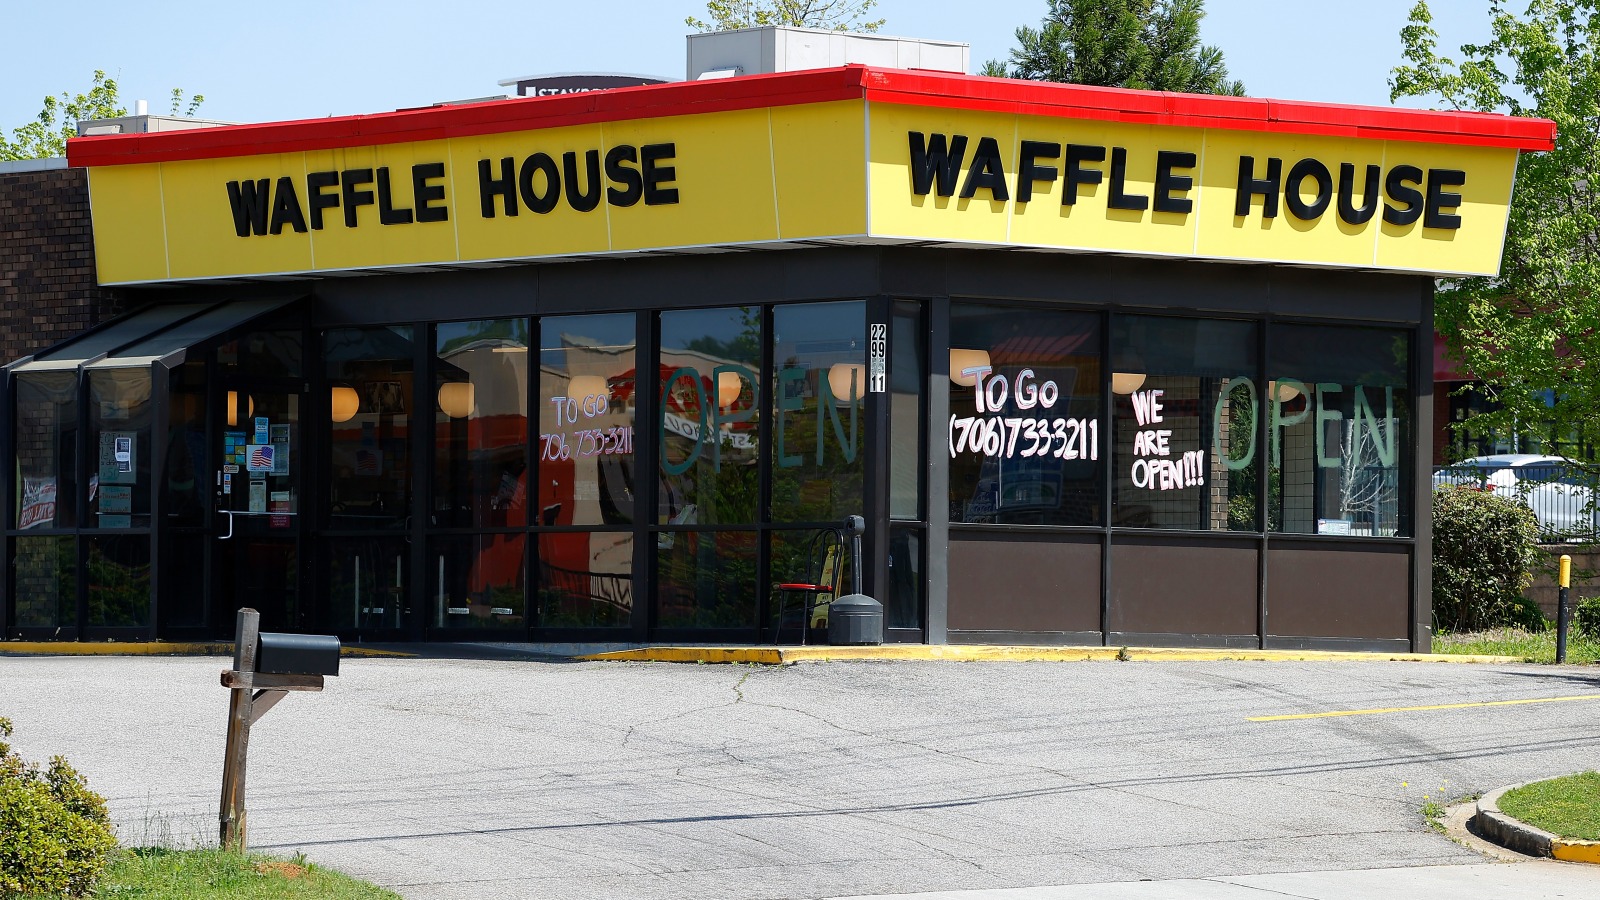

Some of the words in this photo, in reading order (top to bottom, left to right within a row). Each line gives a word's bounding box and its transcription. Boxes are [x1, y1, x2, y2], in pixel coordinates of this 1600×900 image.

[226, 162, 448, 237] WAFFLE
[478, 143, 679, 218] HOUSE
[908, 131, 1197, 214] WAFFLE
[1234, 155, 1466, 229] HOUSE
[583, 394, 608, 418] GO
[660, 364, 858, 475] OPEN
[1131, 389, 1164, 426] WE
[1213, 376, 1395, 470] OPEN
[540, 433, 571, 461] 706
[1133, 430, 1172, 456] ARE
[1131, 449, 1204, 490] OPEN!!!
